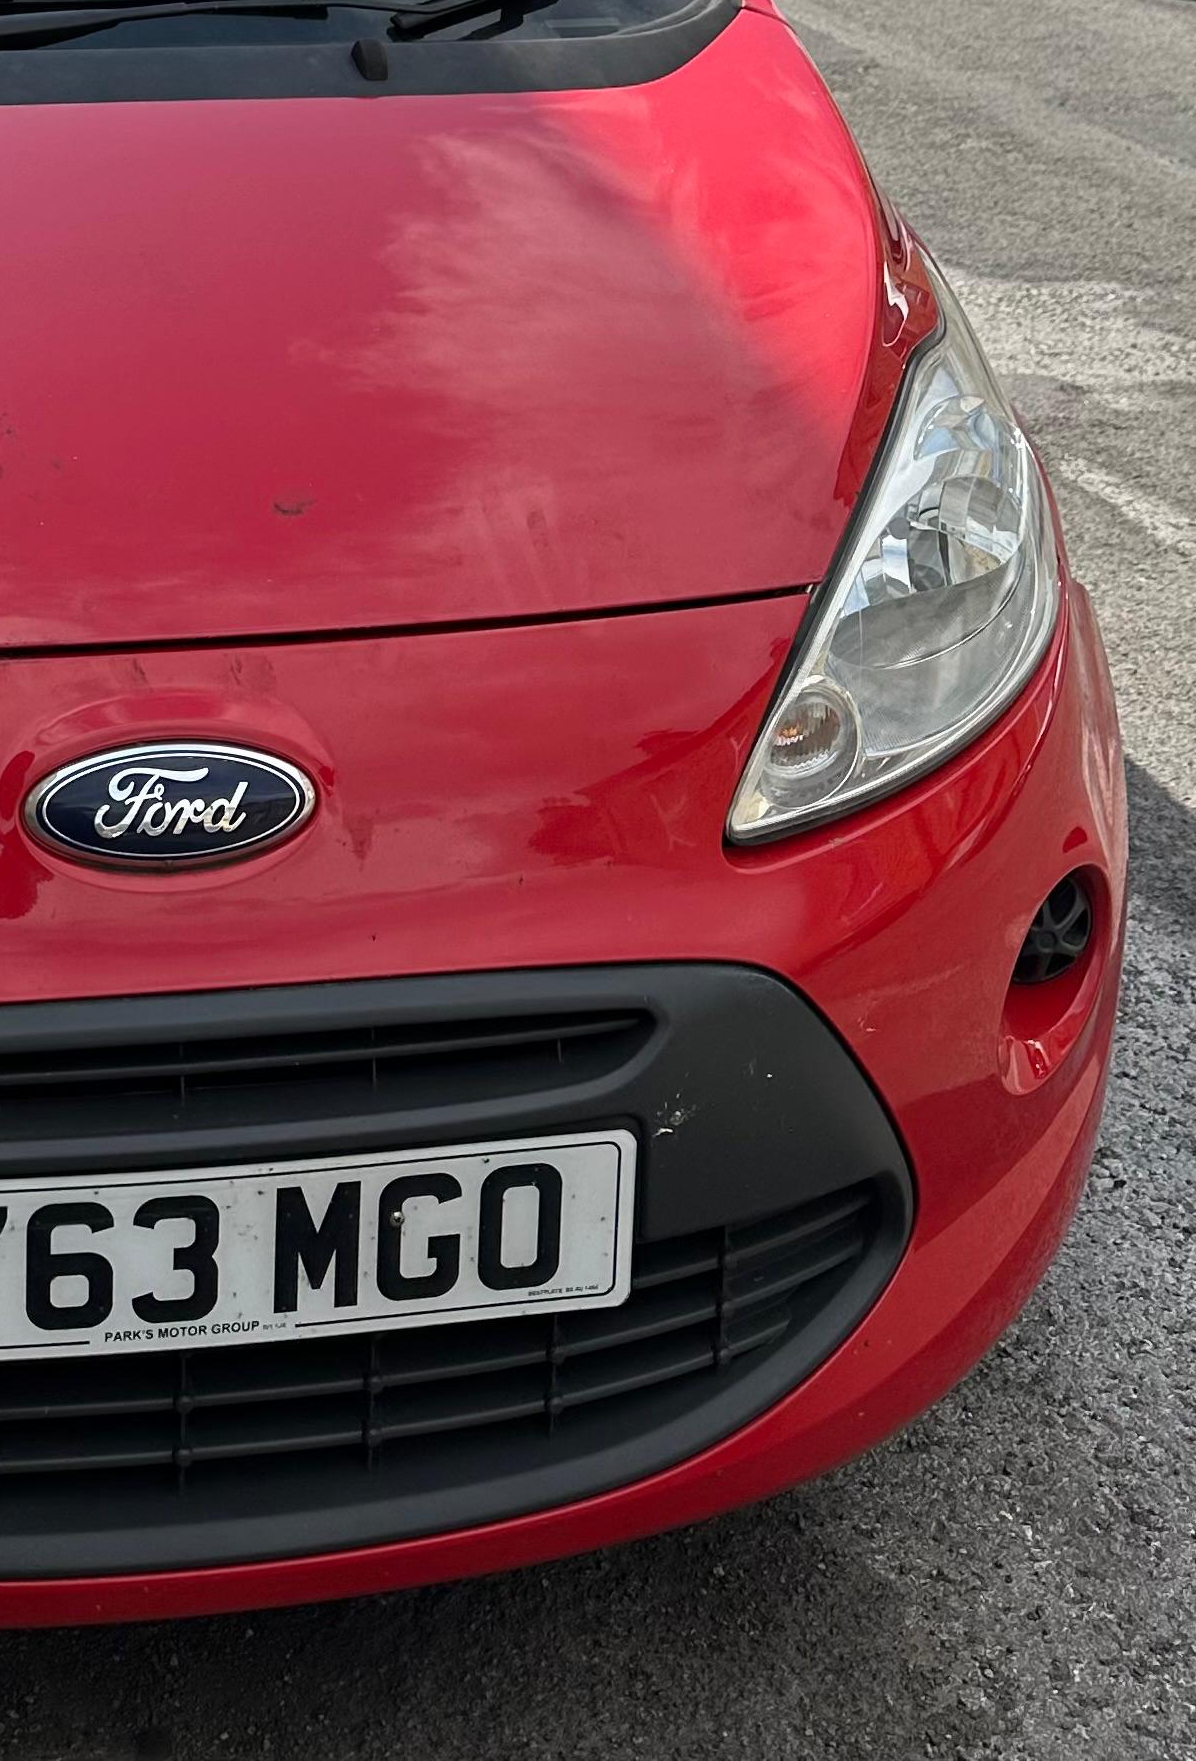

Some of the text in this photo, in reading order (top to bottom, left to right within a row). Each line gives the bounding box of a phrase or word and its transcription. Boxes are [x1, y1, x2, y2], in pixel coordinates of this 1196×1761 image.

[94, 767, 249, 838] Ford
[274, 1162, 563, 1314] MGO
[104, 1329, 154, 1342] PARK'S
[158, 1325, 207, 1339] MOTOR
[211, 1320, 260, 1335] GROUP
